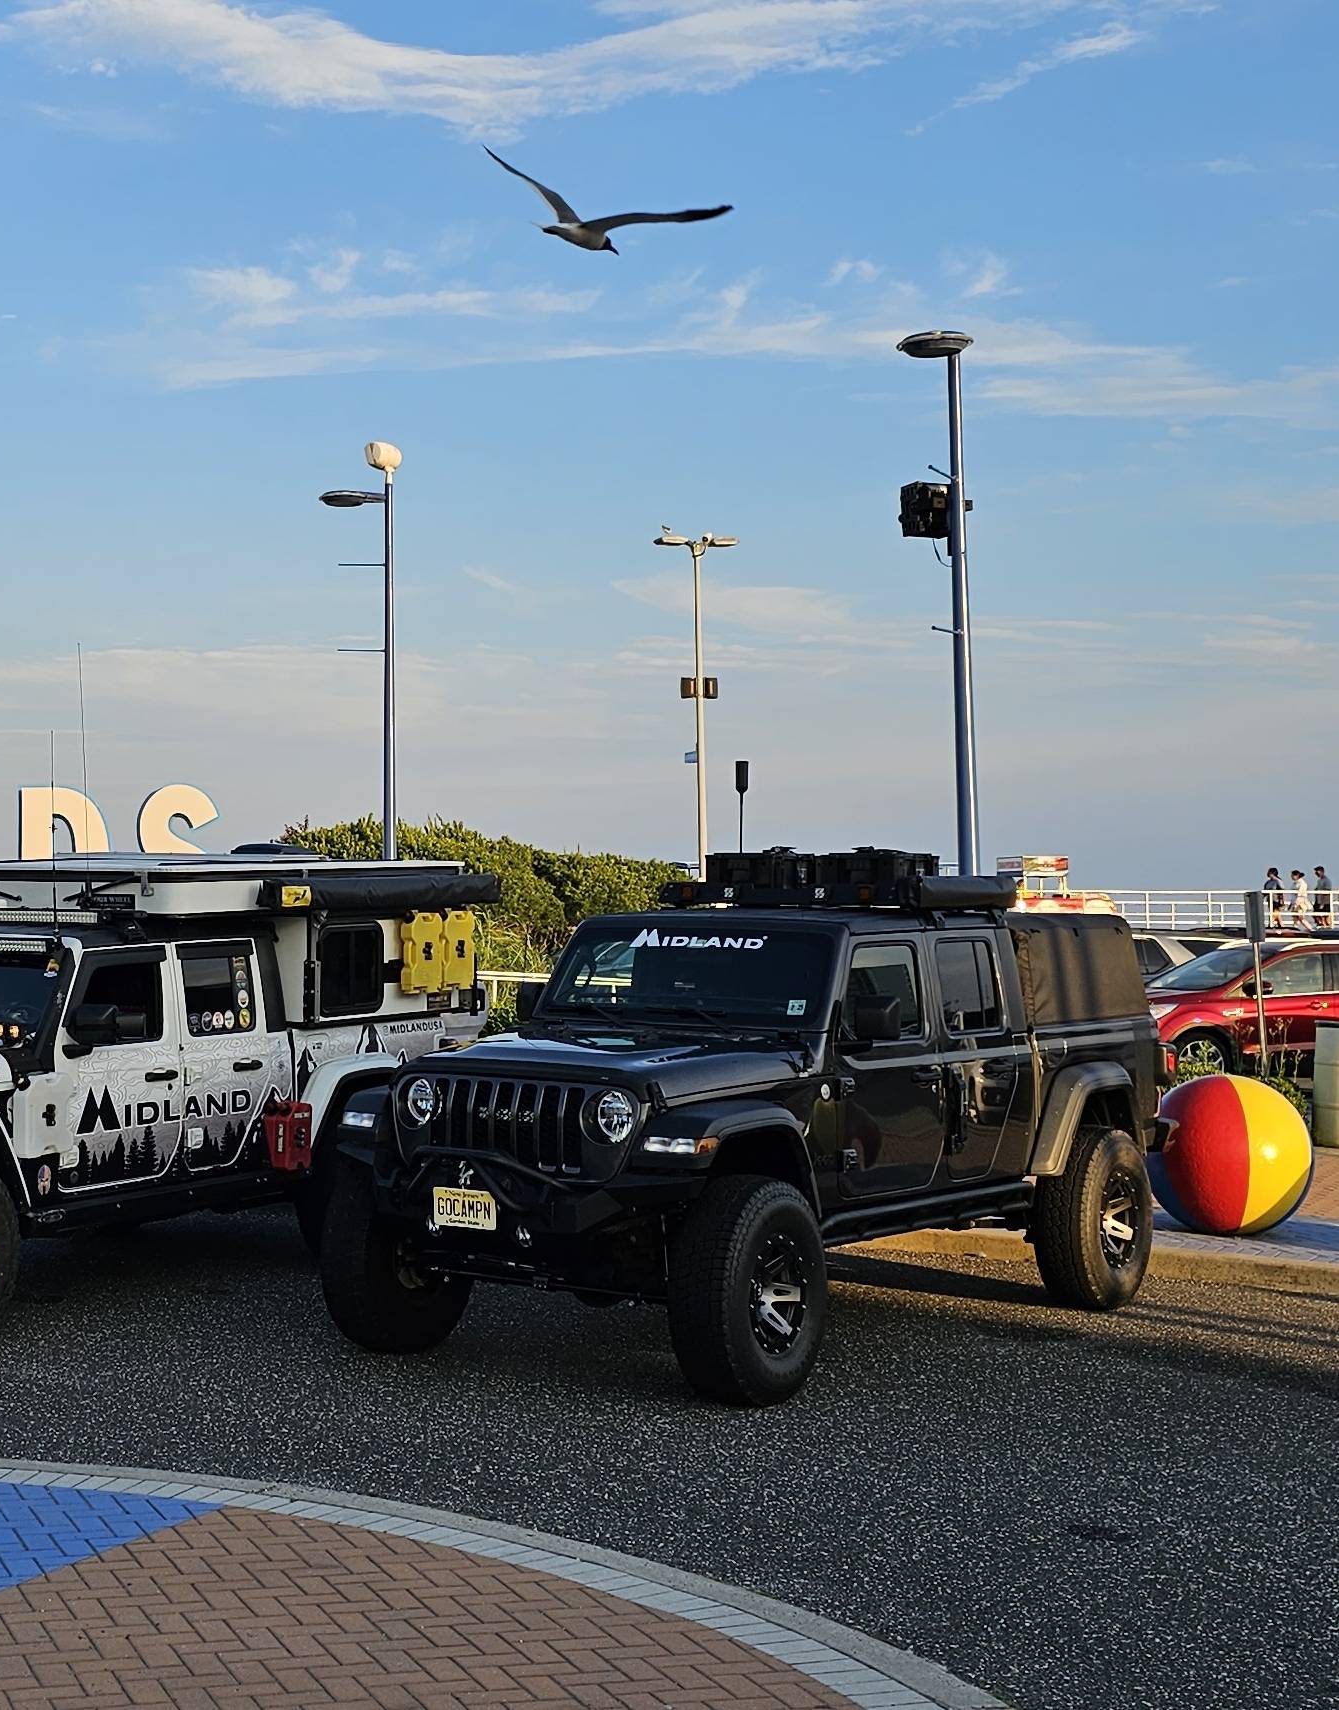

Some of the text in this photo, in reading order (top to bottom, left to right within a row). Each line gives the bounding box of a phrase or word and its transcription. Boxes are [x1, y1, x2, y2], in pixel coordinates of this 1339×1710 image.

[628, 928, 765, 950] MIDLAND
[75, 1085, 252, 1136] MIDLAND
[437, 1196, 491, 1220] GOCAMPN
